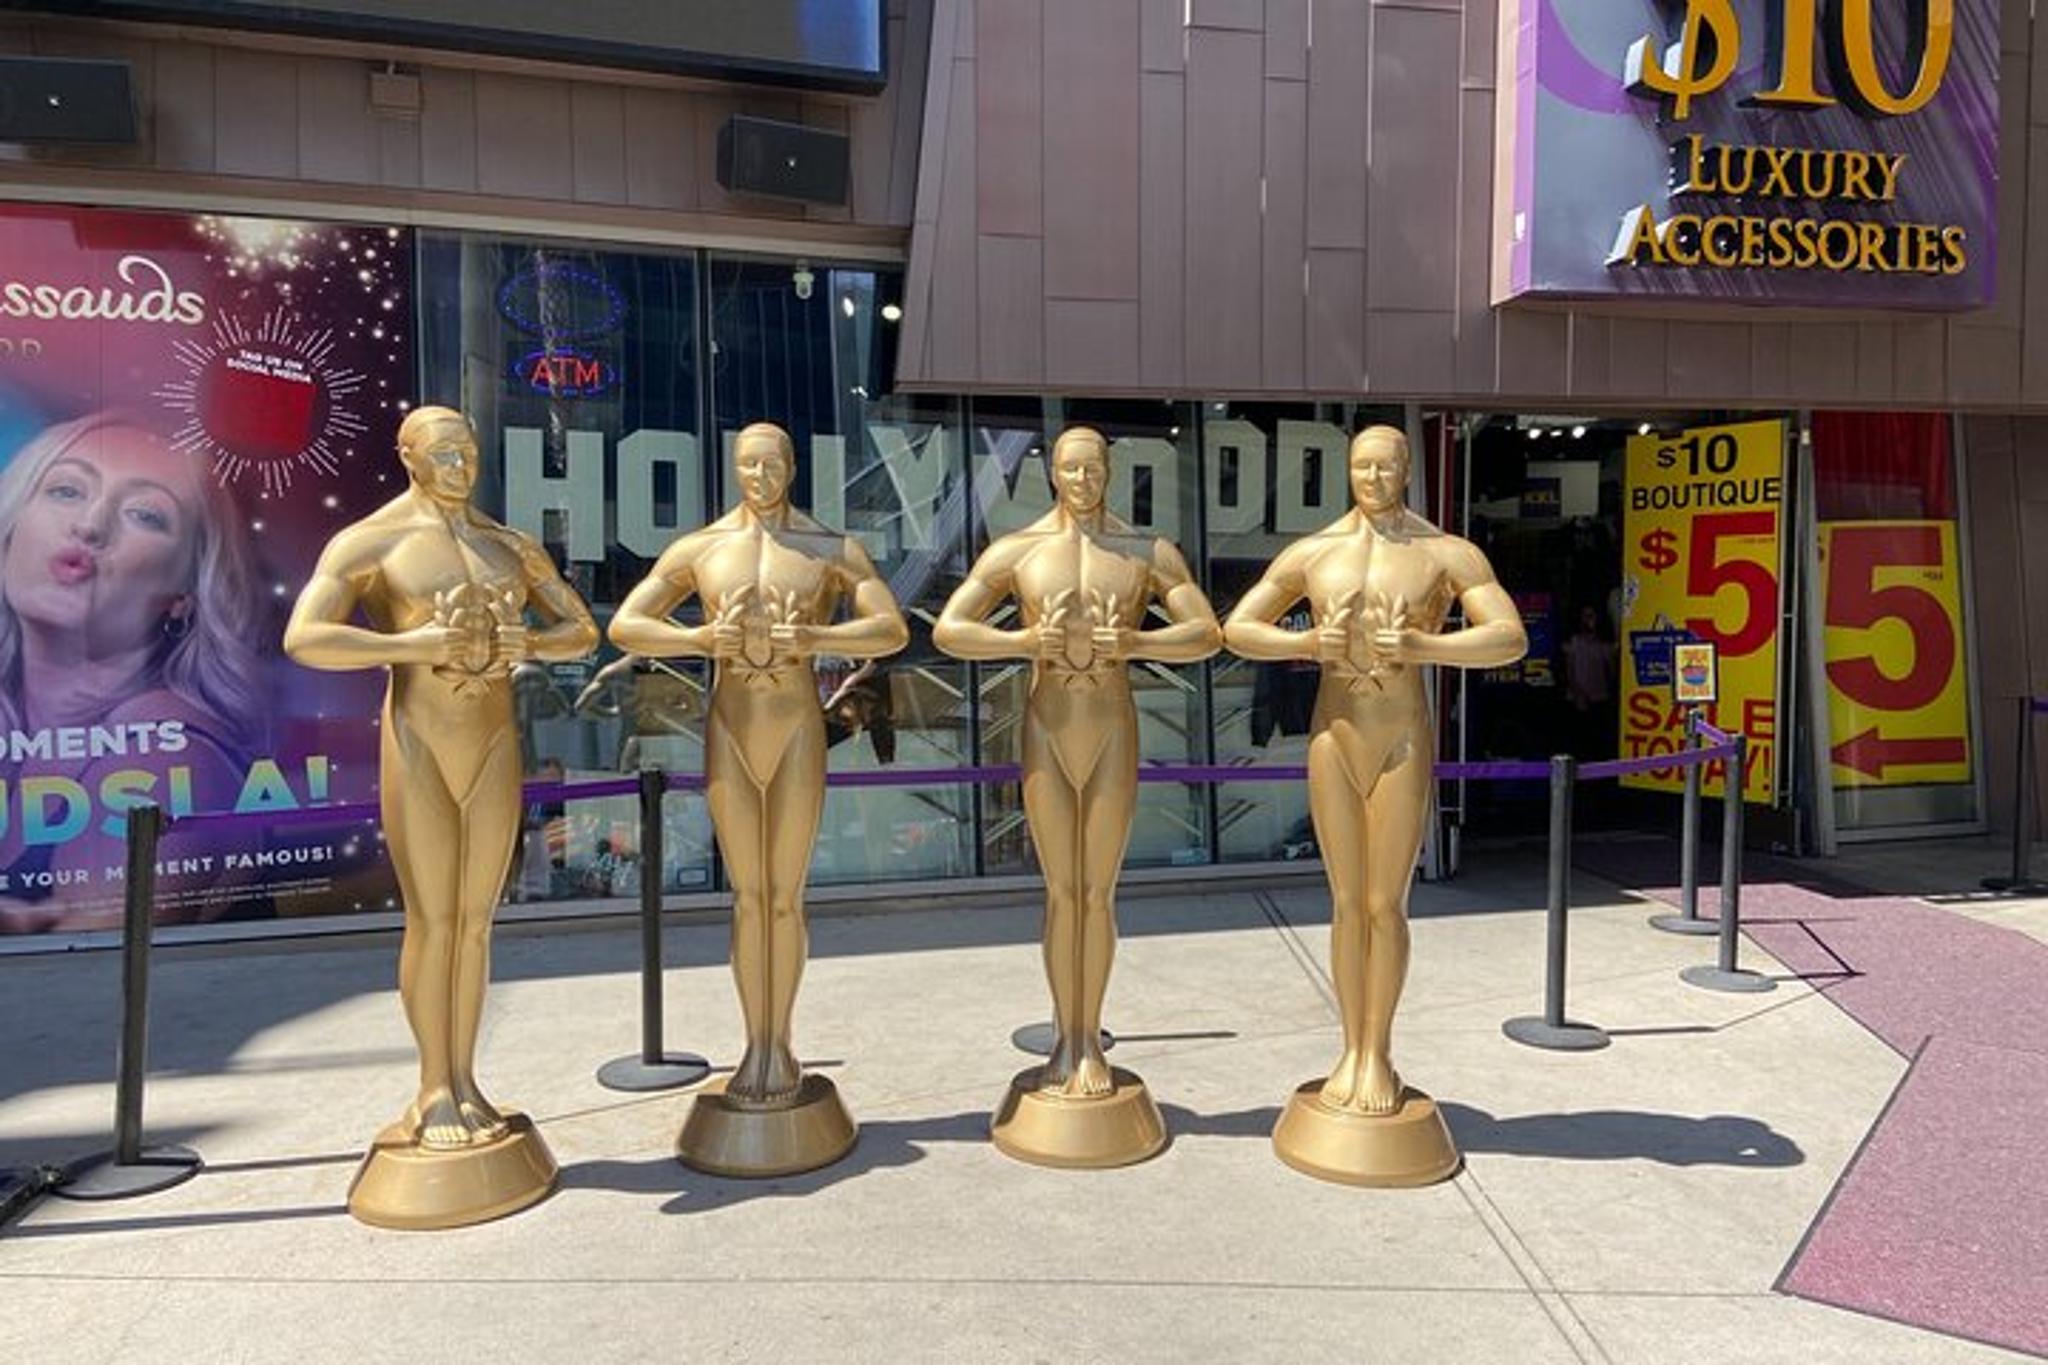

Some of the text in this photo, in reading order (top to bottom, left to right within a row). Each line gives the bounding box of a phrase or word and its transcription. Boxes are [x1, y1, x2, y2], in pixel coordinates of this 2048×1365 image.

[1687, 133, 1908, 200] LUXURY
[1625, 204, 1968, 274] ACCESSORIES
[530, 358, 599, 387] ATM
[1632, 477, 1782, 511] BOUTIQUE
[21, 870, 89, 888] YOUR
[105, 857, 213, 882] MENT
[225, 846, 333, 869] FAMOUS!
